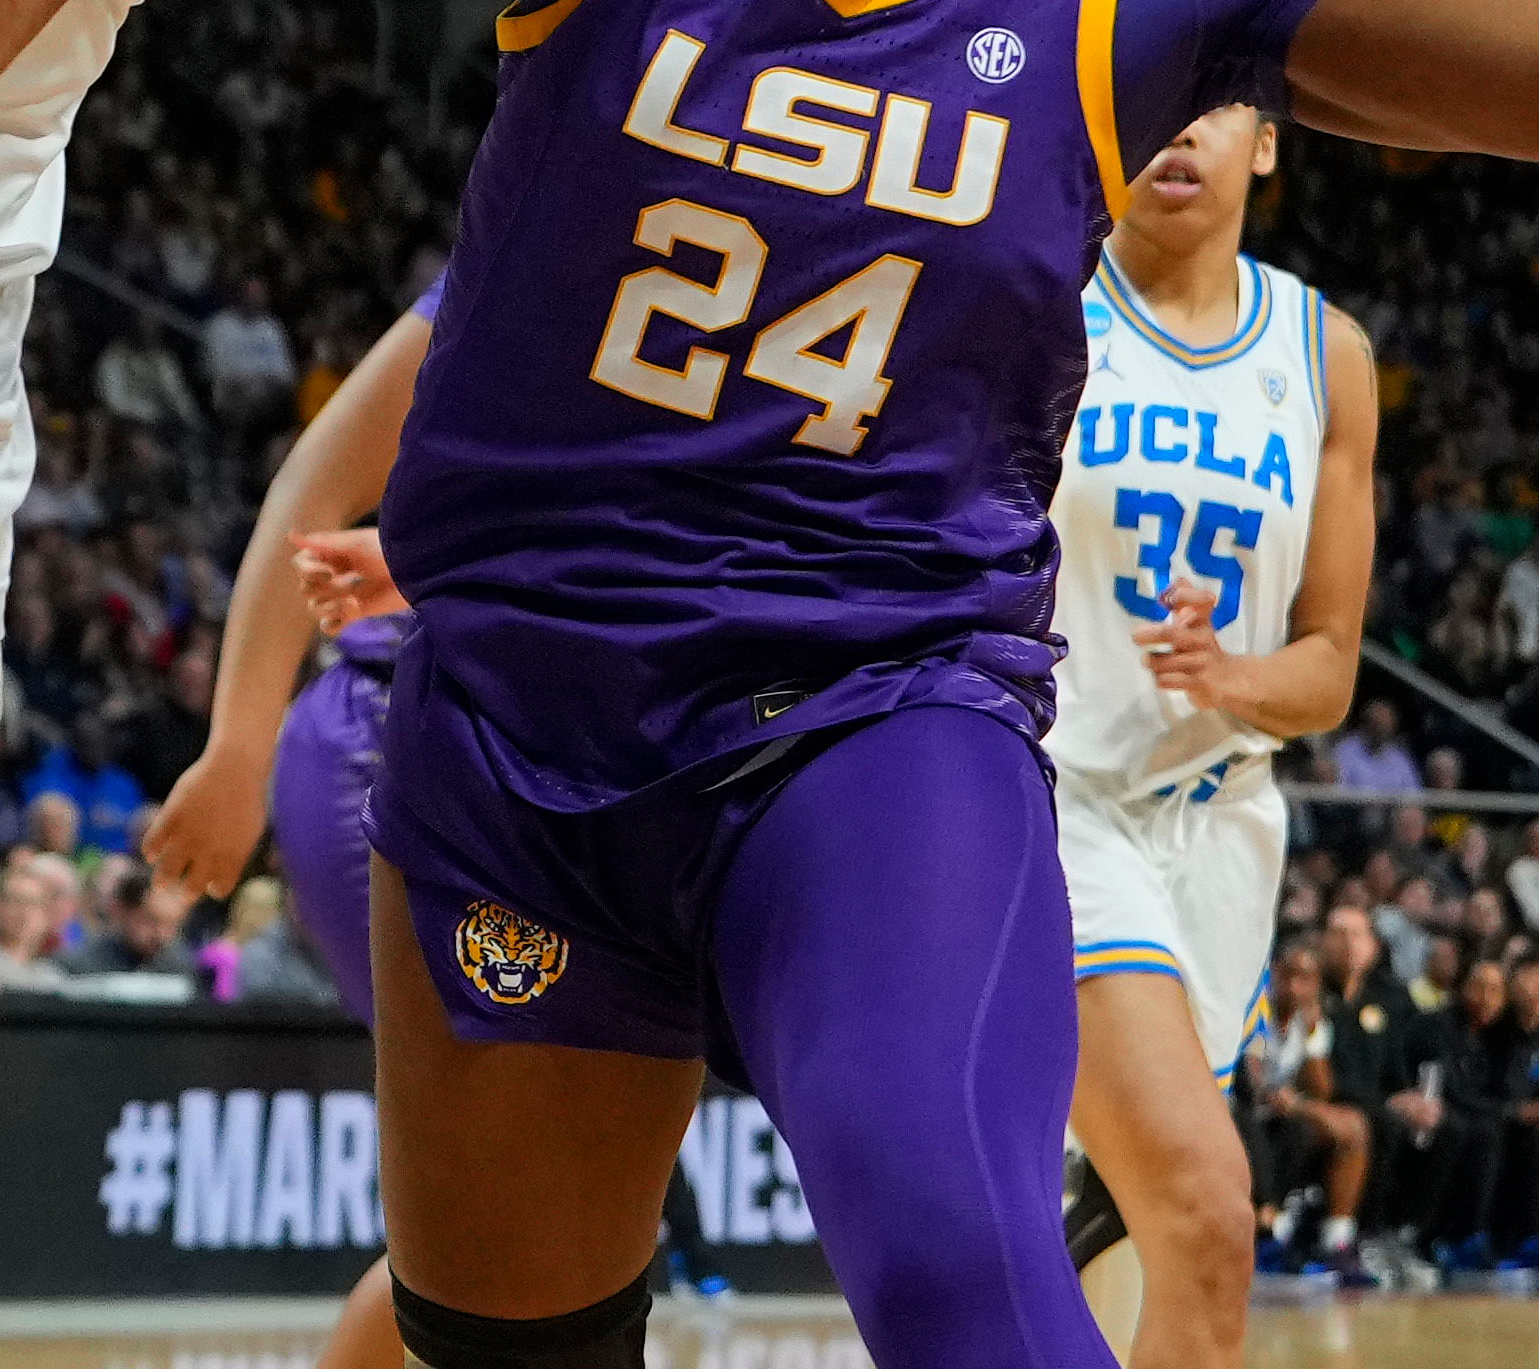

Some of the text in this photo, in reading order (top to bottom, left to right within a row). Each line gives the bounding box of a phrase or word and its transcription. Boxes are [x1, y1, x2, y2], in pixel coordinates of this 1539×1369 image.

[623, 28, 1011, 227] LSU
[971, 31, 1021, 79] SEC
[589, 197, 924, 456] 24
[1077, 403, 1294, 510] UCLA
[1113, 488, 1265, 633] 35
